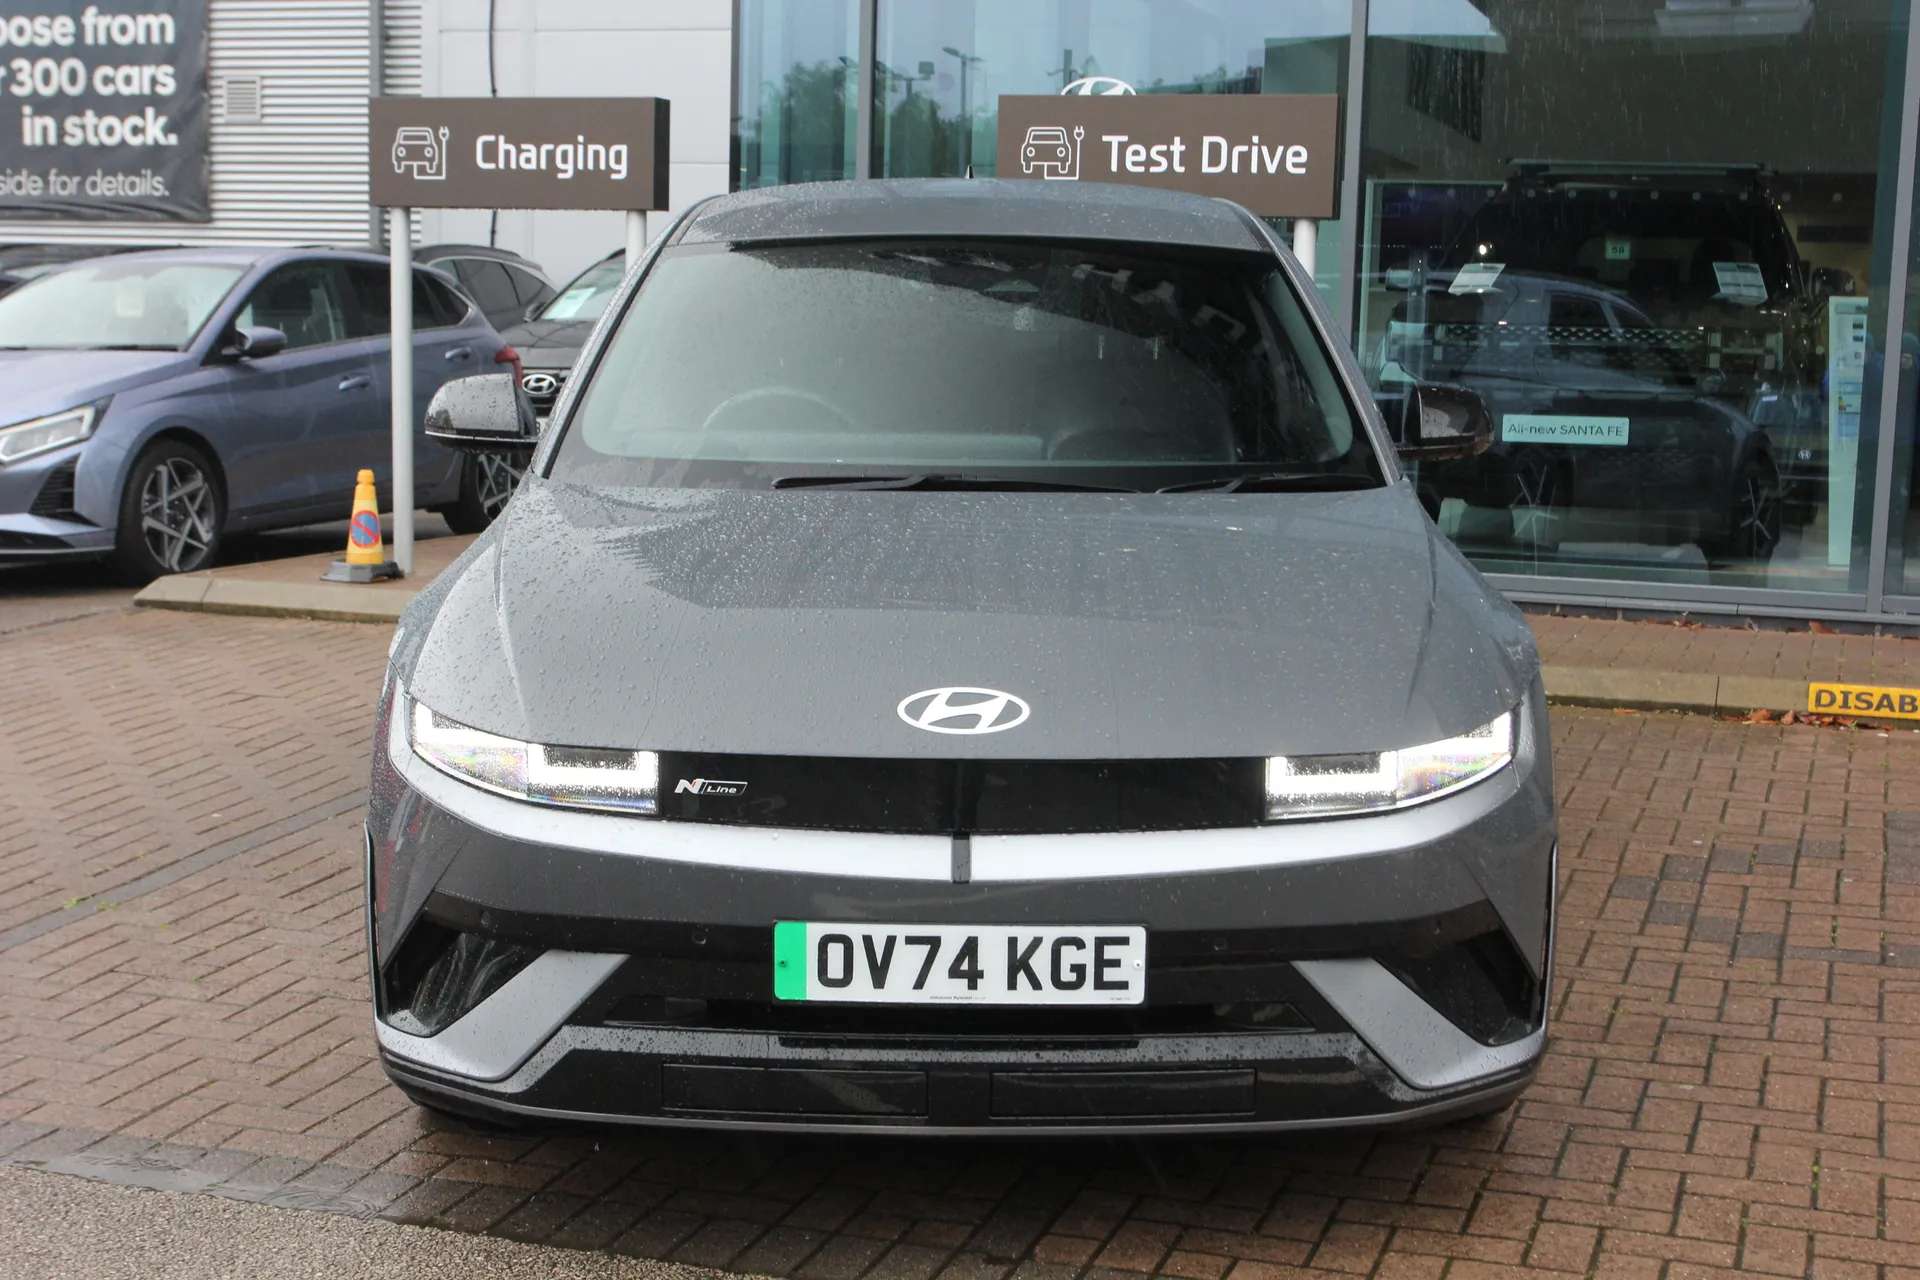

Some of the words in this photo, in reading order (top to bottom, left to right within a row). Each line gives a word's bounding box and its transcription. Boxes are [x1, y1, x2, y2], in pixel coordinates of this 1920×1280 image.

[82, 5, 175, 46] from
[9, 57, 87, 97] 300
[93, 64, 176, 96] cars
[22, 105, 57, 146] in
[63, 106, 178, 146] stock.
[475, 134, 628, 180] Charging
[1101, 135, 1186, 173] Test
[1201, 135, 1308, 174] Drive
[48, 168, 81, 196] for
[85, 168, 170, 196] details.
[1560, 424, 1605, 436] SANTA
[1607, 426, 1624, 437] FE
[1815, 689, 1919, 713] DISAB
[817, 933, 984, 990] OV74
[1007, 936, 1130, 991] KGE
